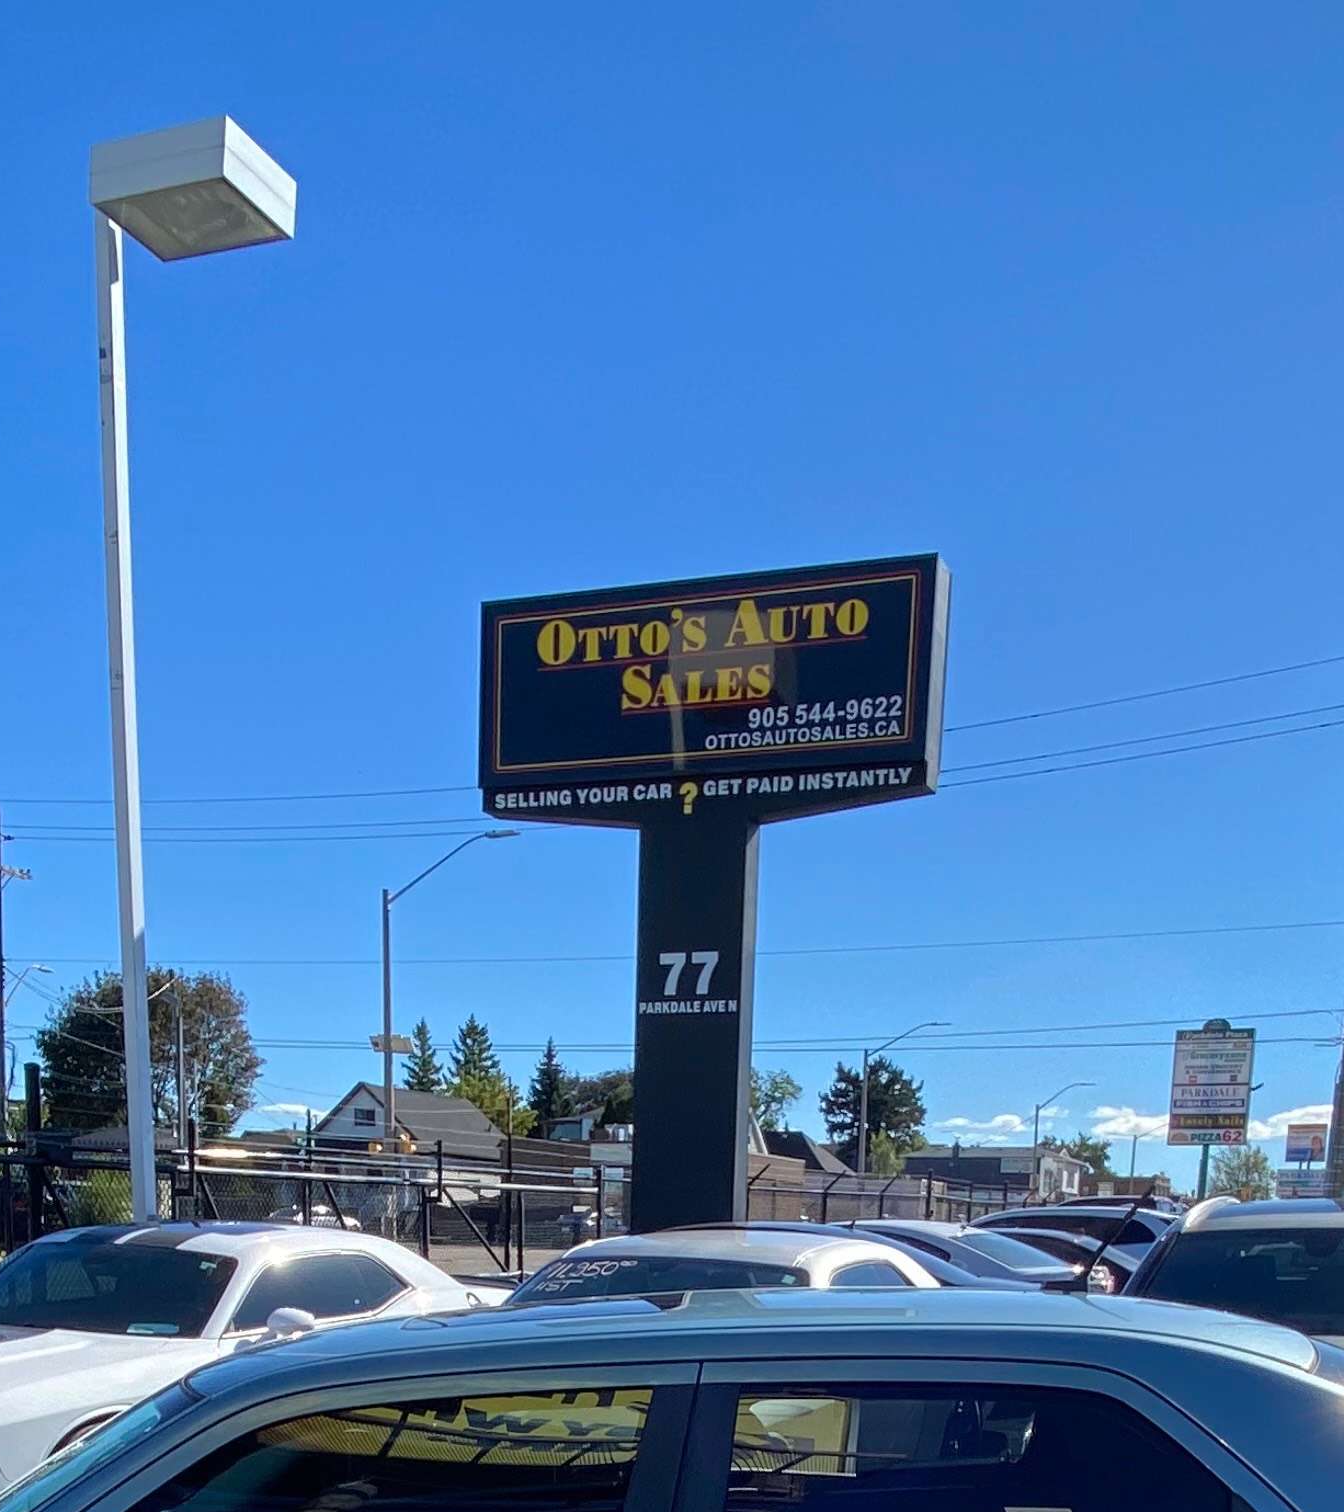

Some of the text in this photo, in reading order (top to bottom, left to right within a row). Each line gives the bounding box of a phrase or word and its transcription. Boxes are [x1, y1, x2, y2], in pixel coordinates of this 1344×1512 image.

[724, 599, 869, 647] AUTO
[621, 664, 771, 710] SALES
[748, 695, 903, 728] 905 544-9622
[705, 720, 900, 750] OTTOSAUTOSALES.CA
[494, 789, 572, 809] SELLING
[575, 786, 629, 804] YOUR
[633, 783, 672, 800] CAR
[703, 779, 741, 796] GET
[746, 775, 793, 794] PAID
[798, 767, 912, 791] INSTANTLY
[659, 951, 719, 996] 77
[639, 999, 737, 1014] PARKDALE AVE N
[1190, 1130, 1242, 1142] PIZZA 62
